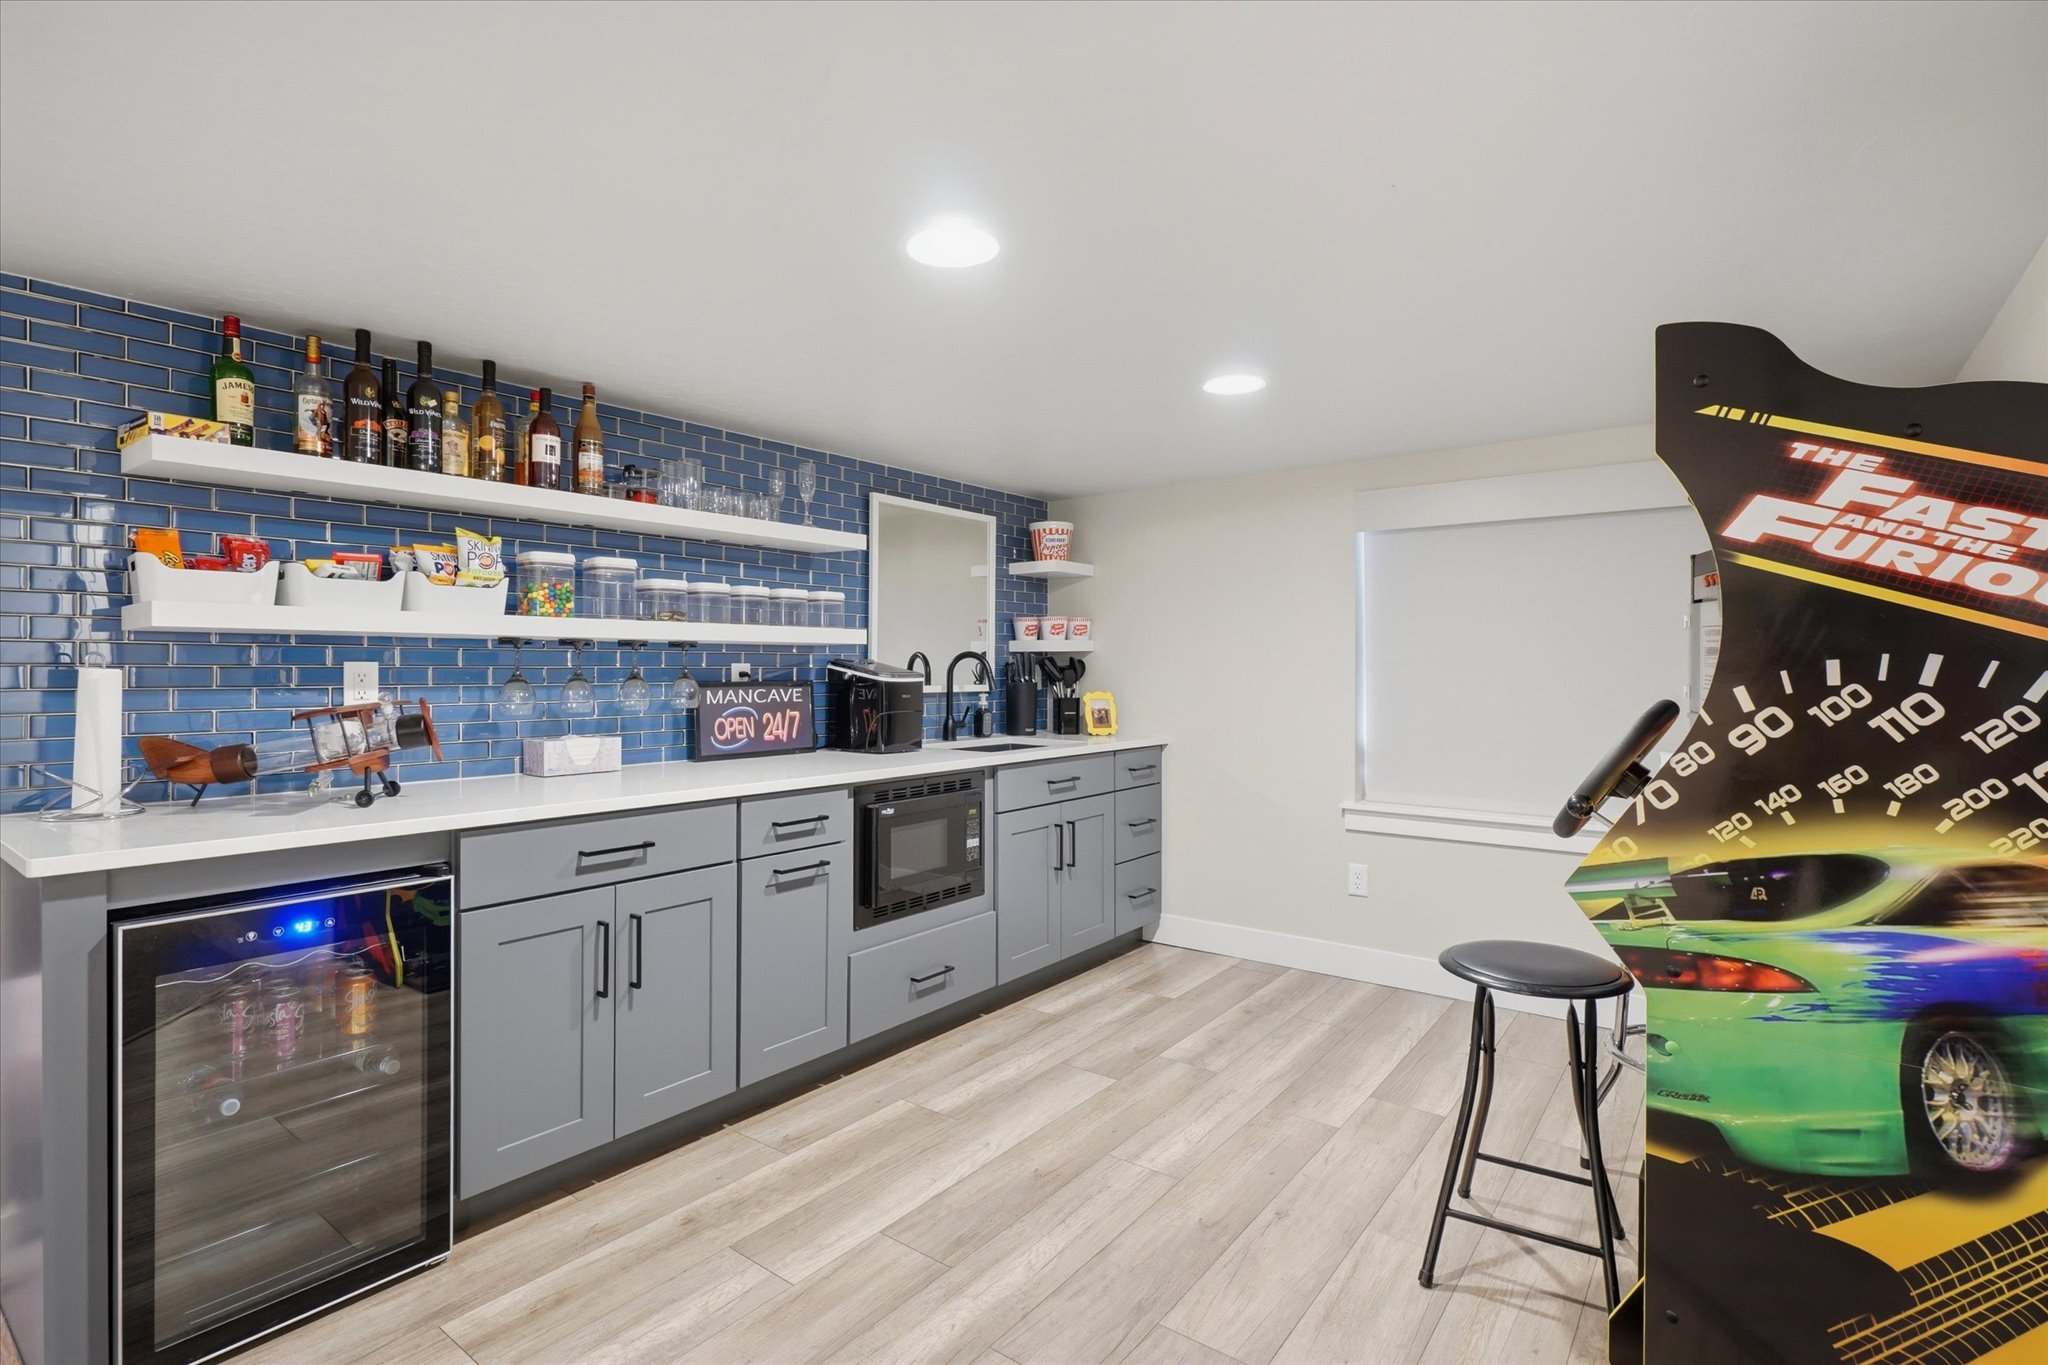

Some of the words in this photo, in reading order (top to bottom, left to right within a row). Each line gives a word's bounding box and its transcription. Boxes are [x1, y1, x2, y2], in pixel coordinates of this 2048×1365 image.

[1790, 441, 1886, 472] THE
[1831, 513, 1926, 541] AND
[1924, 531, 2018, 560] THE
[706, 687, 803, 705] MANCAVE
[1807, 683, 1872, 727] 100
[714, 716, 755, 741] OPEN
[762, 708, 801, 744] 24/7
[1728, 706, 1794, 756] 90
[1867, 692, 1945, 743] 110
[1961, 705, 2041, 754] 120
[1670, 741, 1715, 777] 80
[1818, 765, 1869, 799] 160
[1883, 763, 1940, 799] 180
[1754, 784, 1802, 816] 140
[1942, 778, 2009, 822] 200
[1707, 812, 1753, 843] 120
[1988, 817, 2048, 857] 220
[295, 920, 313, 932] 43
